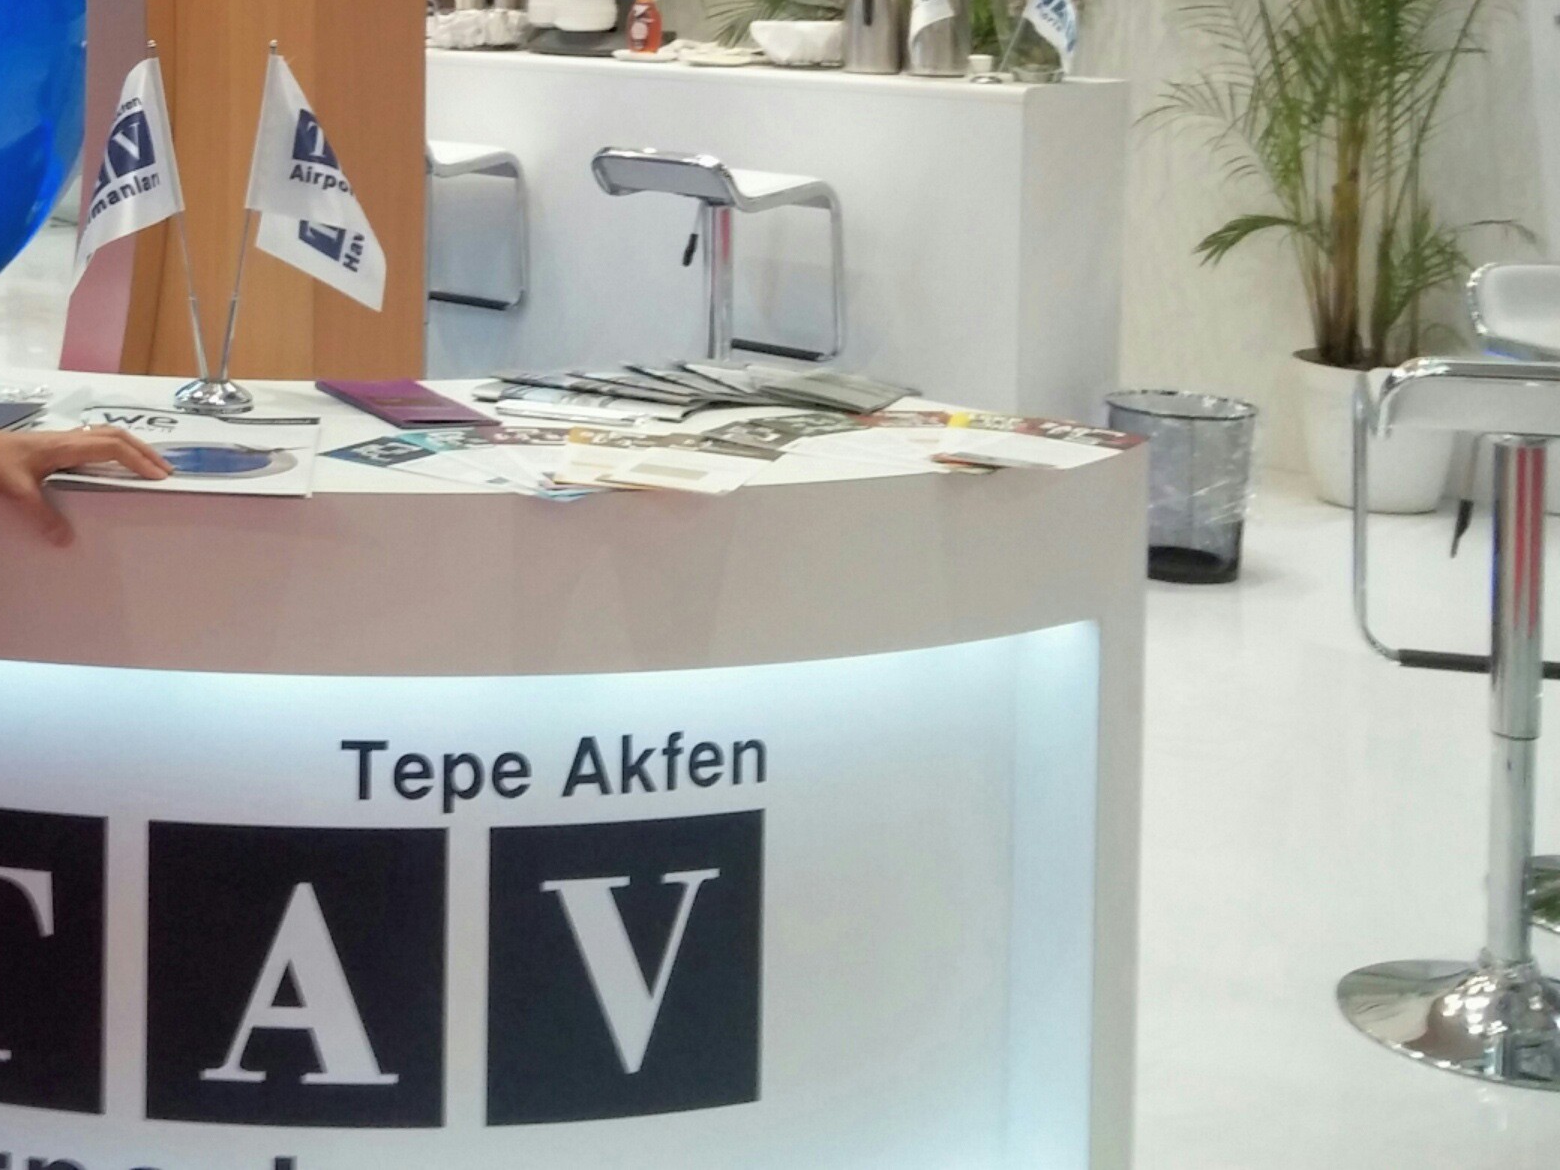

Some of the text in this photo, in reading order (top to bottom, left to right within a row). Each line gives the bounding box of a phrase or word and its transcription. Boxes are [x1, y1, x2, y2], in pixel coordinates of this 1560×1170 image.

[290, 164, 354, 196] Airpo
[341, 731, 768, 814] Tepe Akfen
